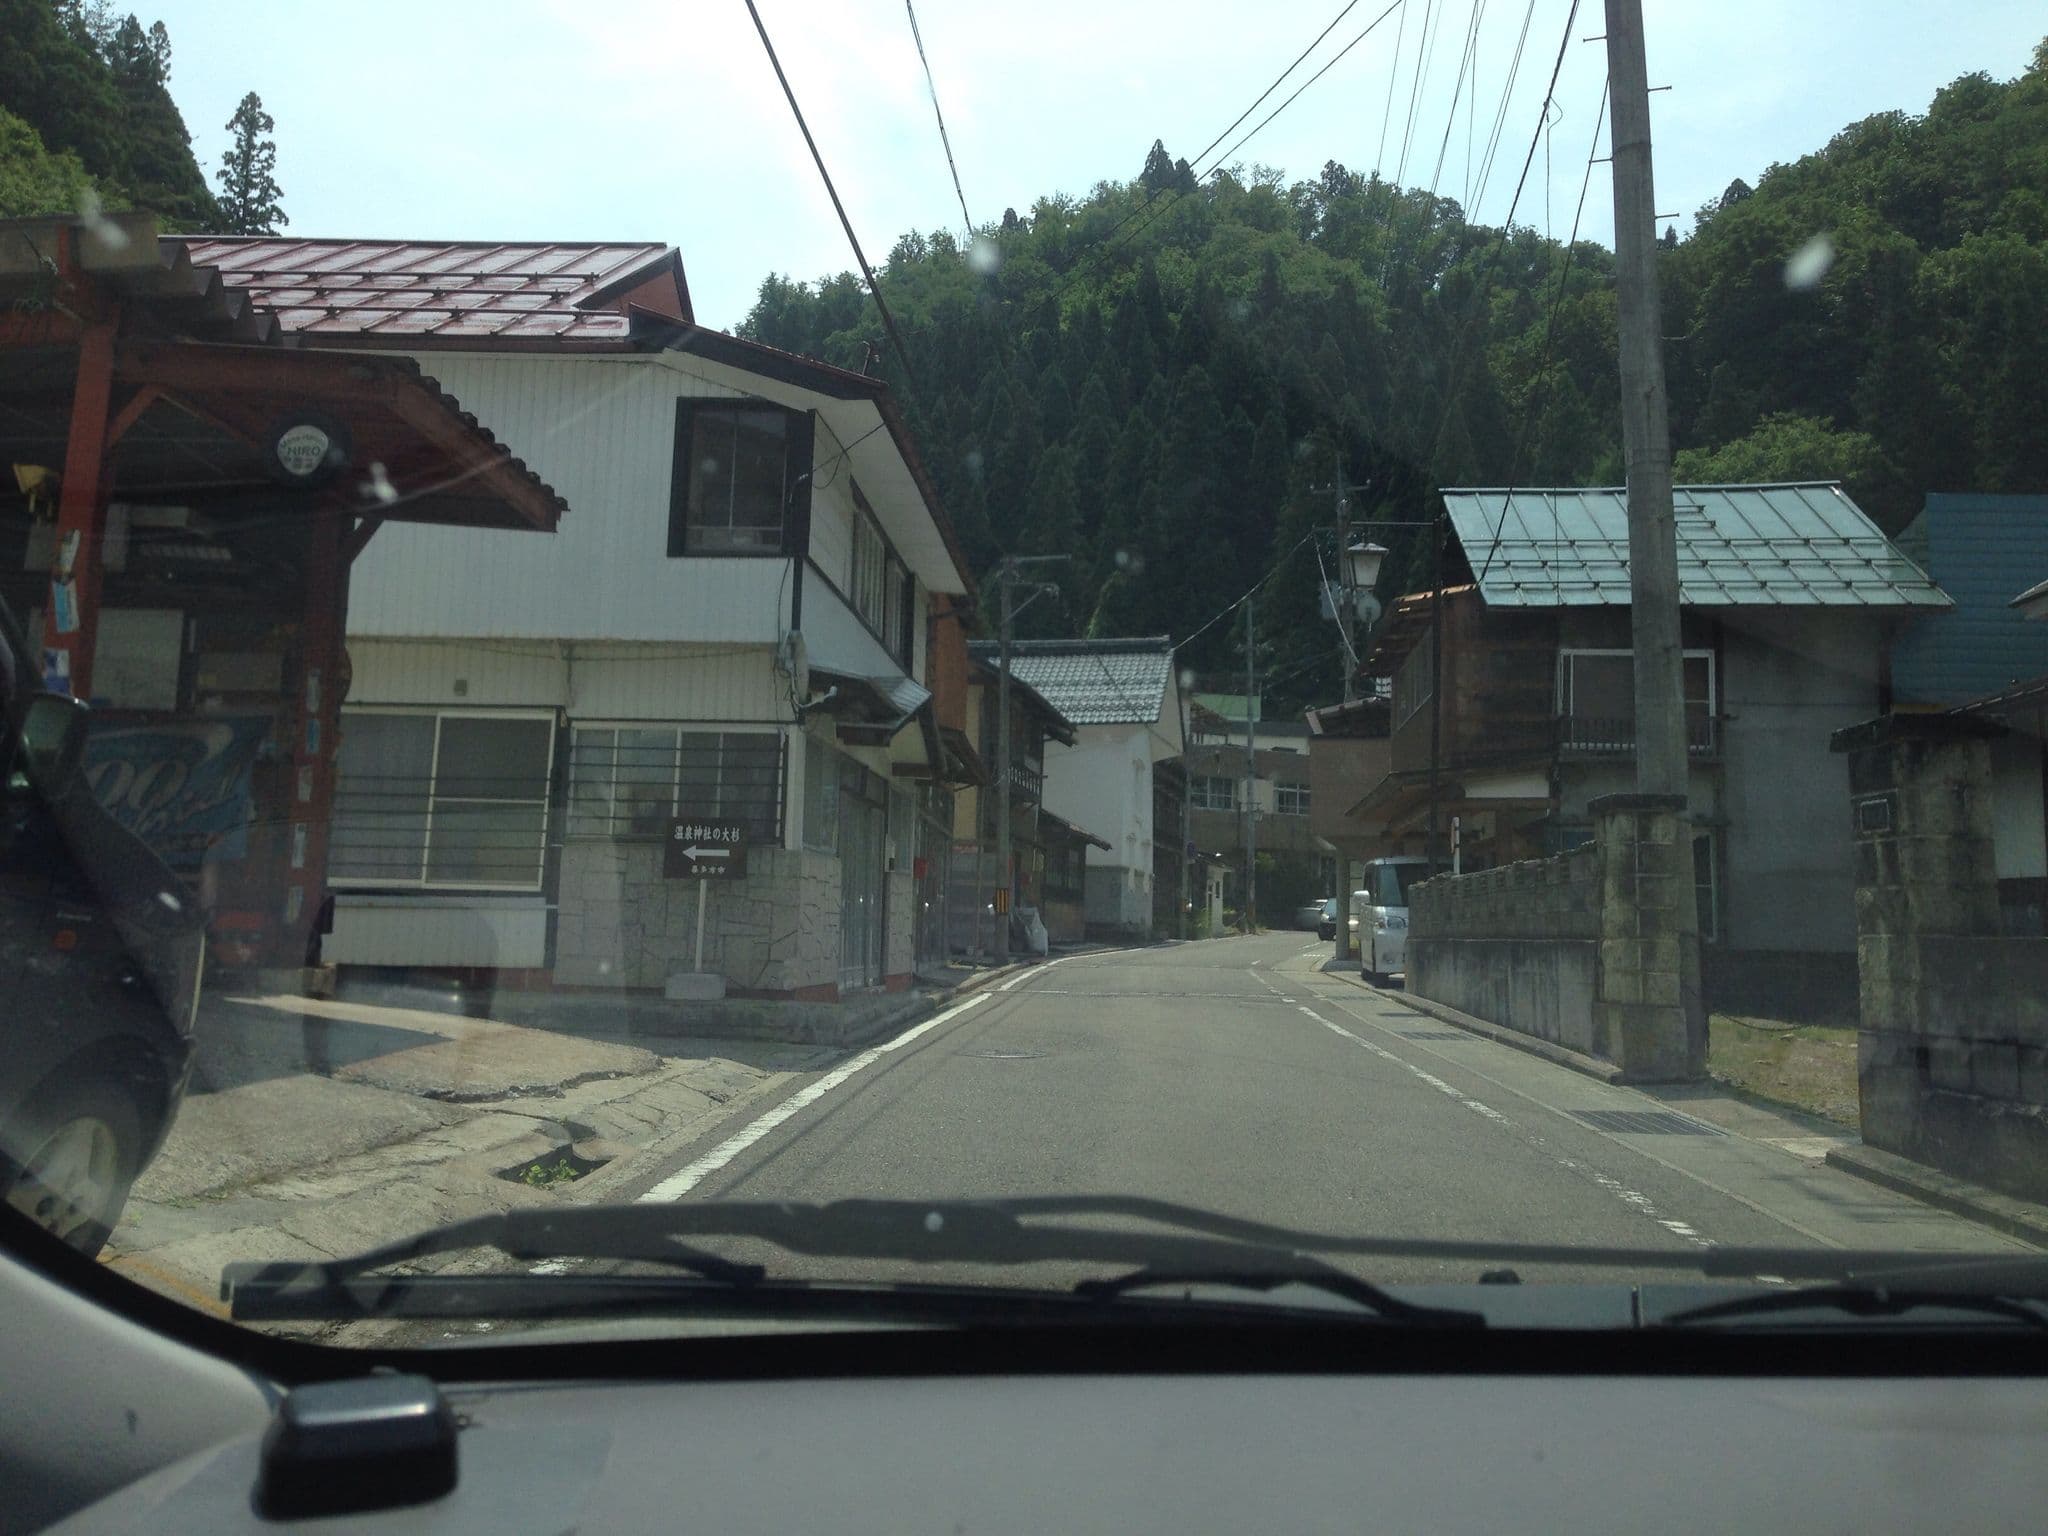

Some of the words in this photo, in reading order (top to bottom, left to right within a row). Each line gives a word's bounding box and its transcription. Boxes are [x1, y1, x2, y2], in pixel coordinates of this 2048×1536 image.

[674, 824, 740, 842] 温泉神社の大杉
